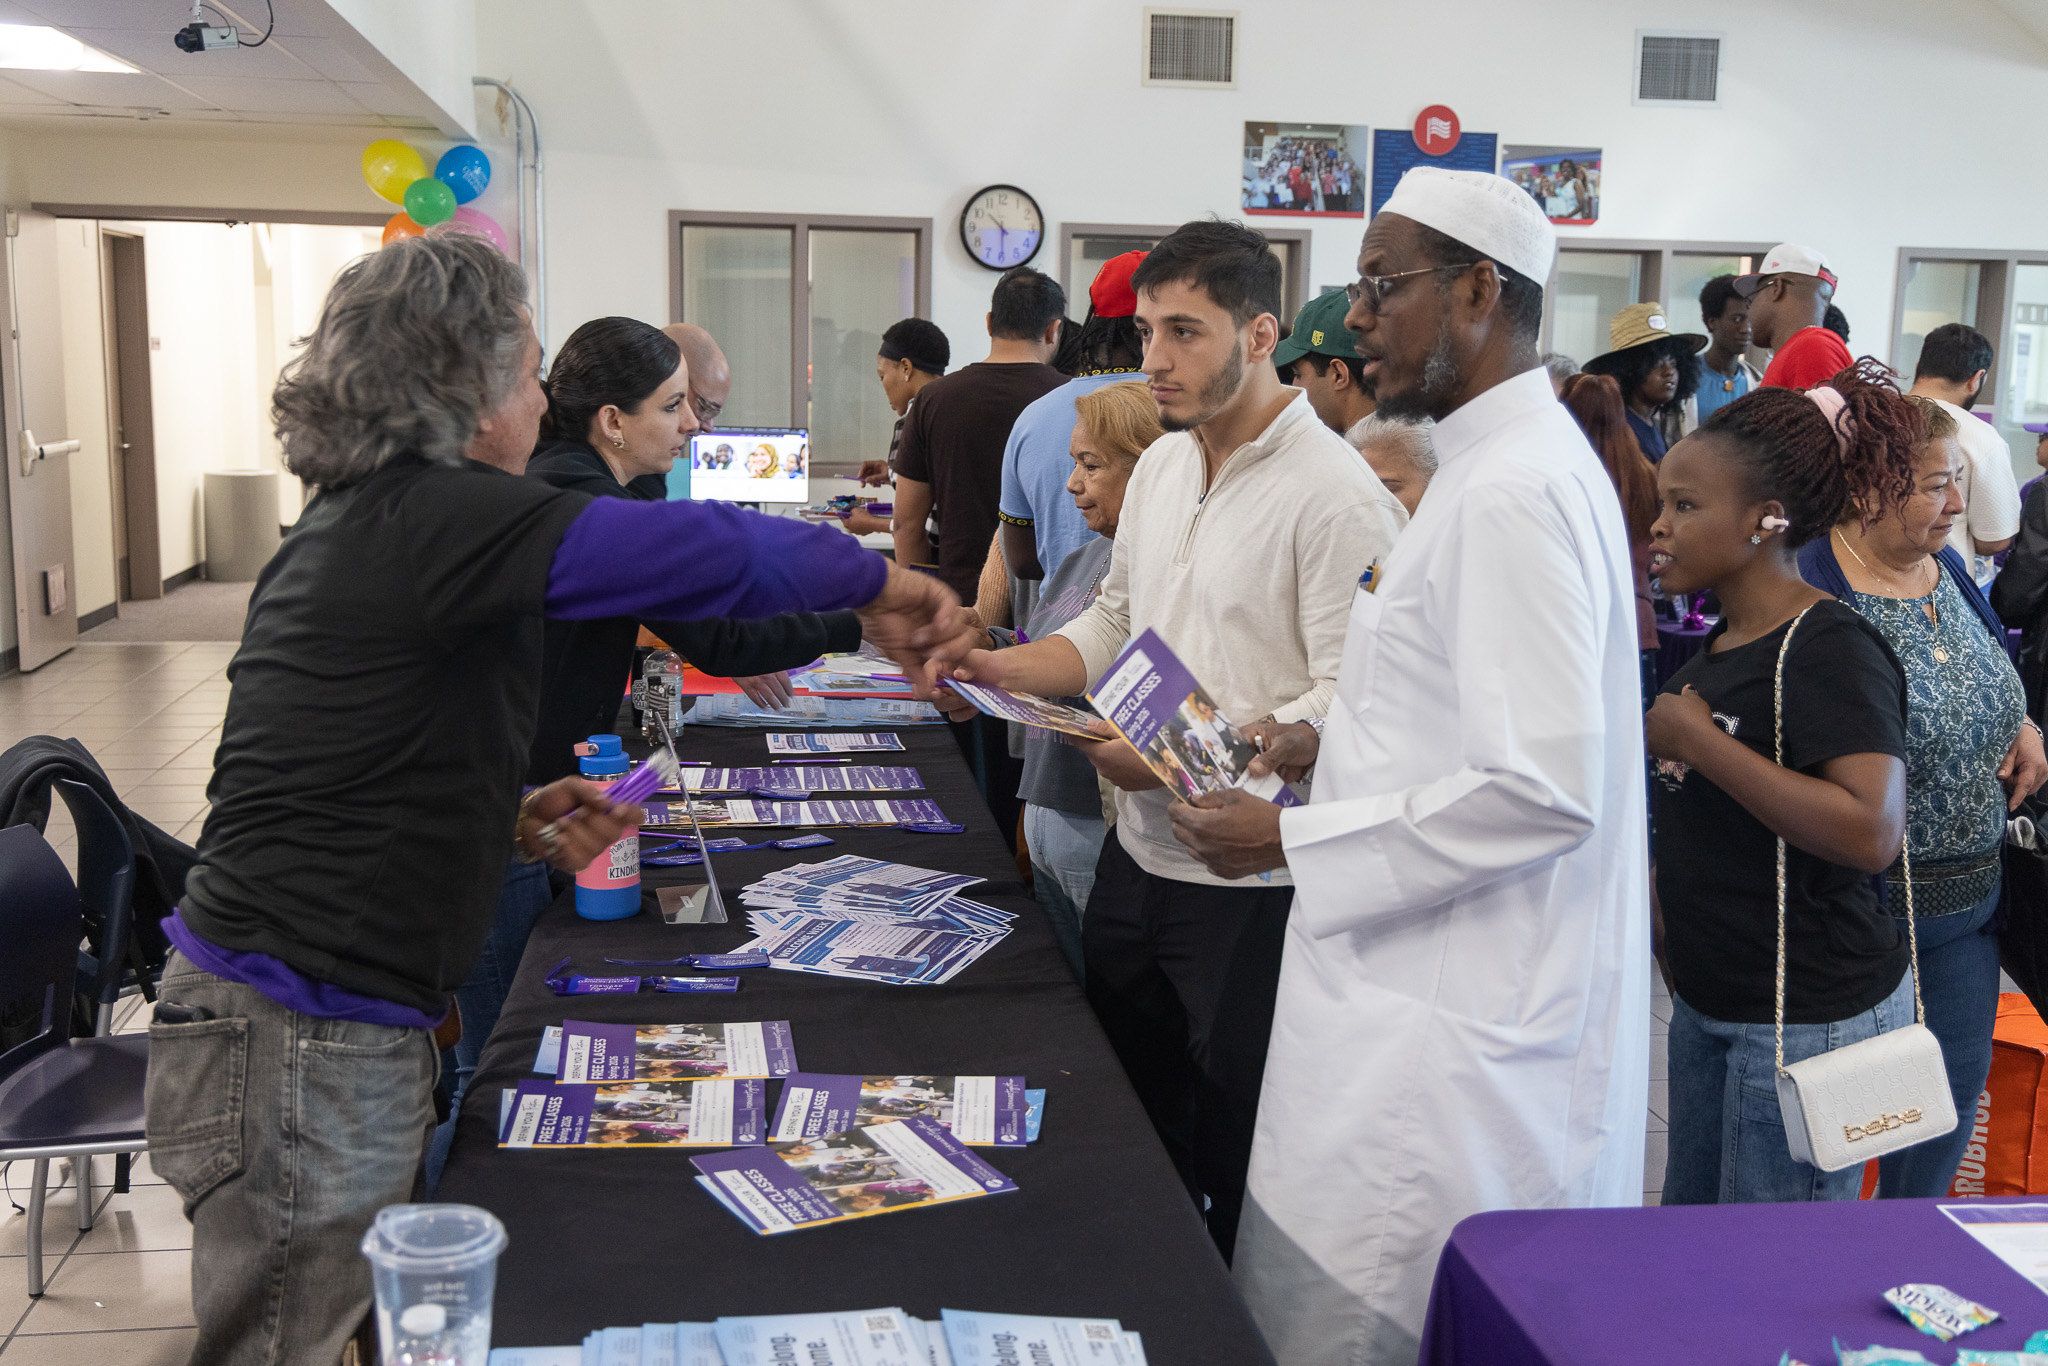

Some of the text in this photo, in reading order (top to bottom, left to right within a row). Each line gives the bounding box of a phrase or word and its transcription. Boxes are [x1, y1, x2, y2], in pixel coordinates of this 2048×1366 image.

[986, 198, 994, 209] 11
[998, 192, 1008, 205] 12
[975, 207, 984, 218] 10
[1024, 209, 1031, 220] 2
[968, 221, 976, 232] 9
[974, 237, 981, 247] 8
[1023, 237, 1030, 248] 4
[985, 247, 992, 258] 7
[998, 251, 1005, 263] 6
[1013, 248, 1020, 259] 5
[1113, 704, 1133, 728] FREE
[1126, 671, 1163, 711] CLASSES
[777, 934, 814, 958] WELCOME
[806, 921, 832, 936] WEEK
[591, 1038, 607, 1079] FREE CLASSES
[538, 1096, 563, 1143] FREE CLASSES
[806, 1090, 830, 1136] FREE CLASSES
[1843, 1107, 1923, 1143] bebe
[743, 1167, 787, 1203] CLASSES
[777, 1201, 809, 1224] FREE
[991, 1330, 1019, 1366] elong.
[1028, 1339, 1054, 1366] ome.
